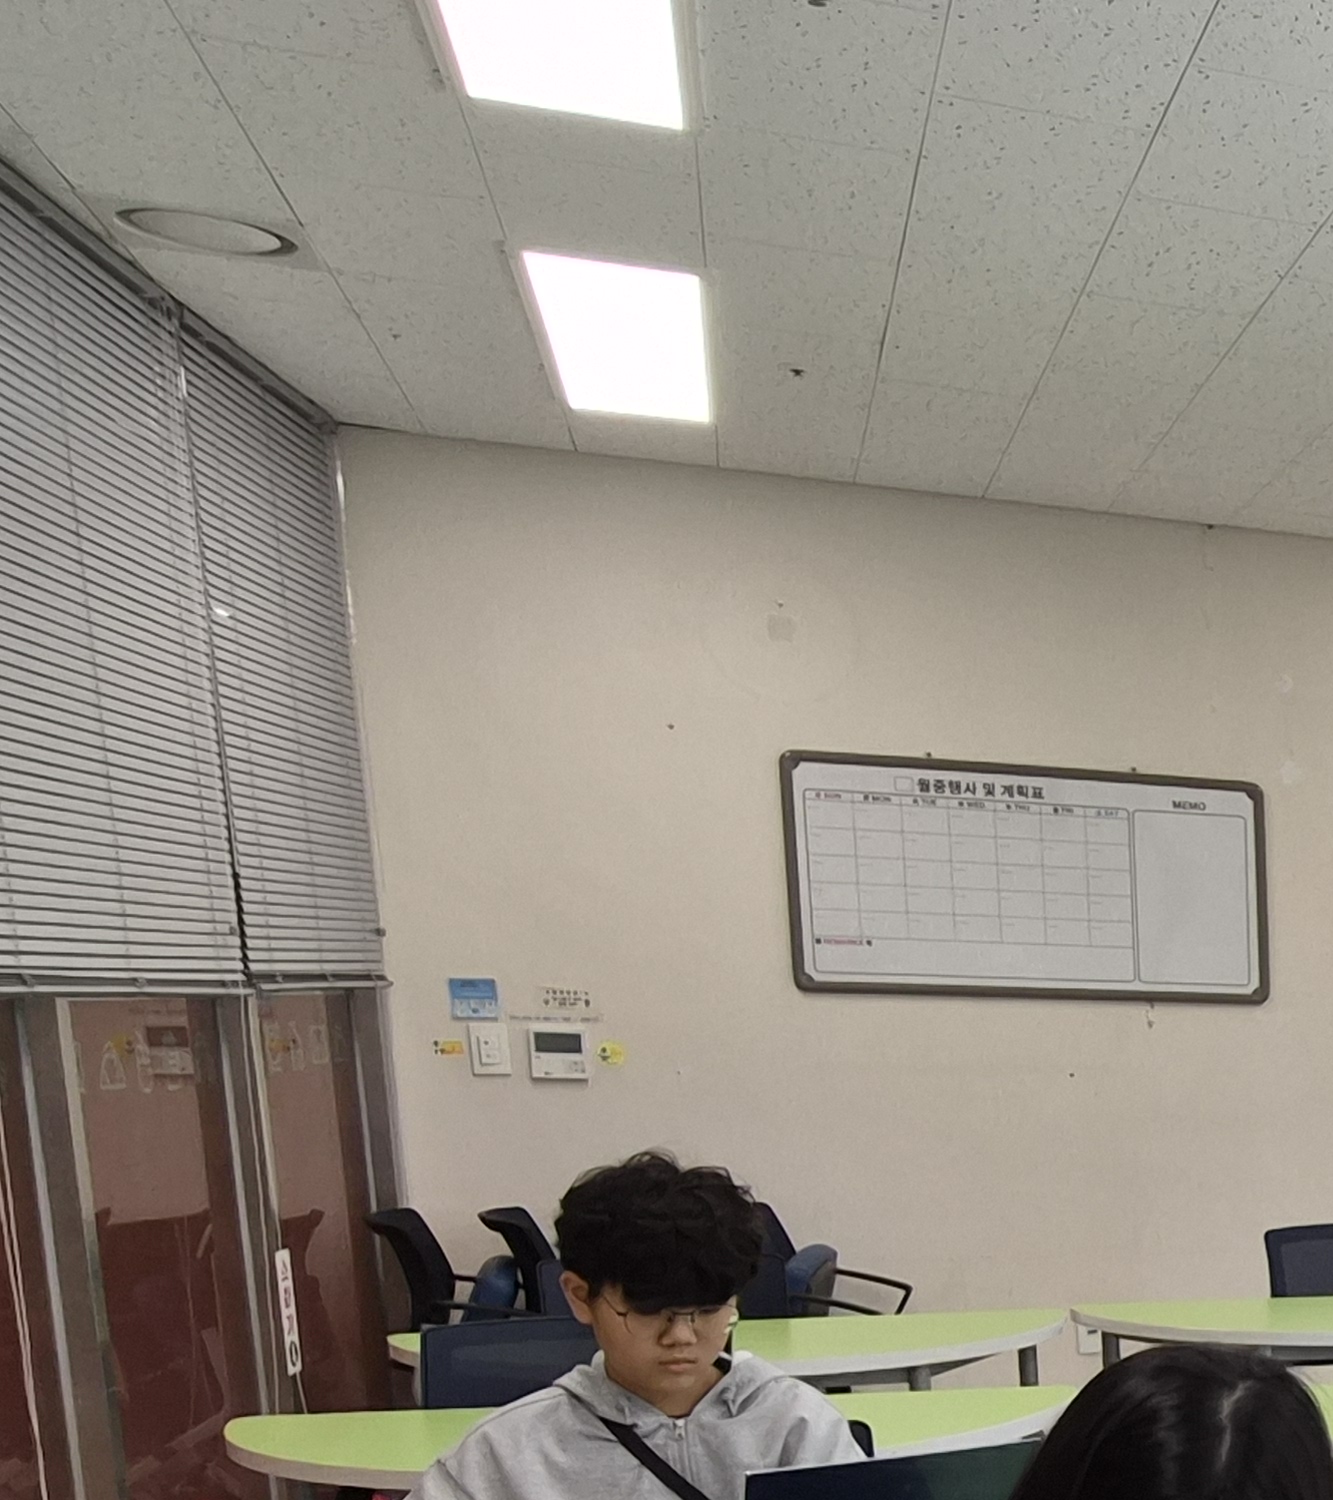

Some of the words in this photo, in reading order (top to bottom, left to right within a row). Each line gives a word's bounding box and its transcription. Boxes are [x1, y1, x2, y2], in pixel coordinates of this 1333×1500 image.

[917, 777, 977, 796] 월중행사
[982, 781, 996, 798] 및
[1000, 783, 1045, 800] 계획표
[1171, 799, 1207, 812] MEMO
